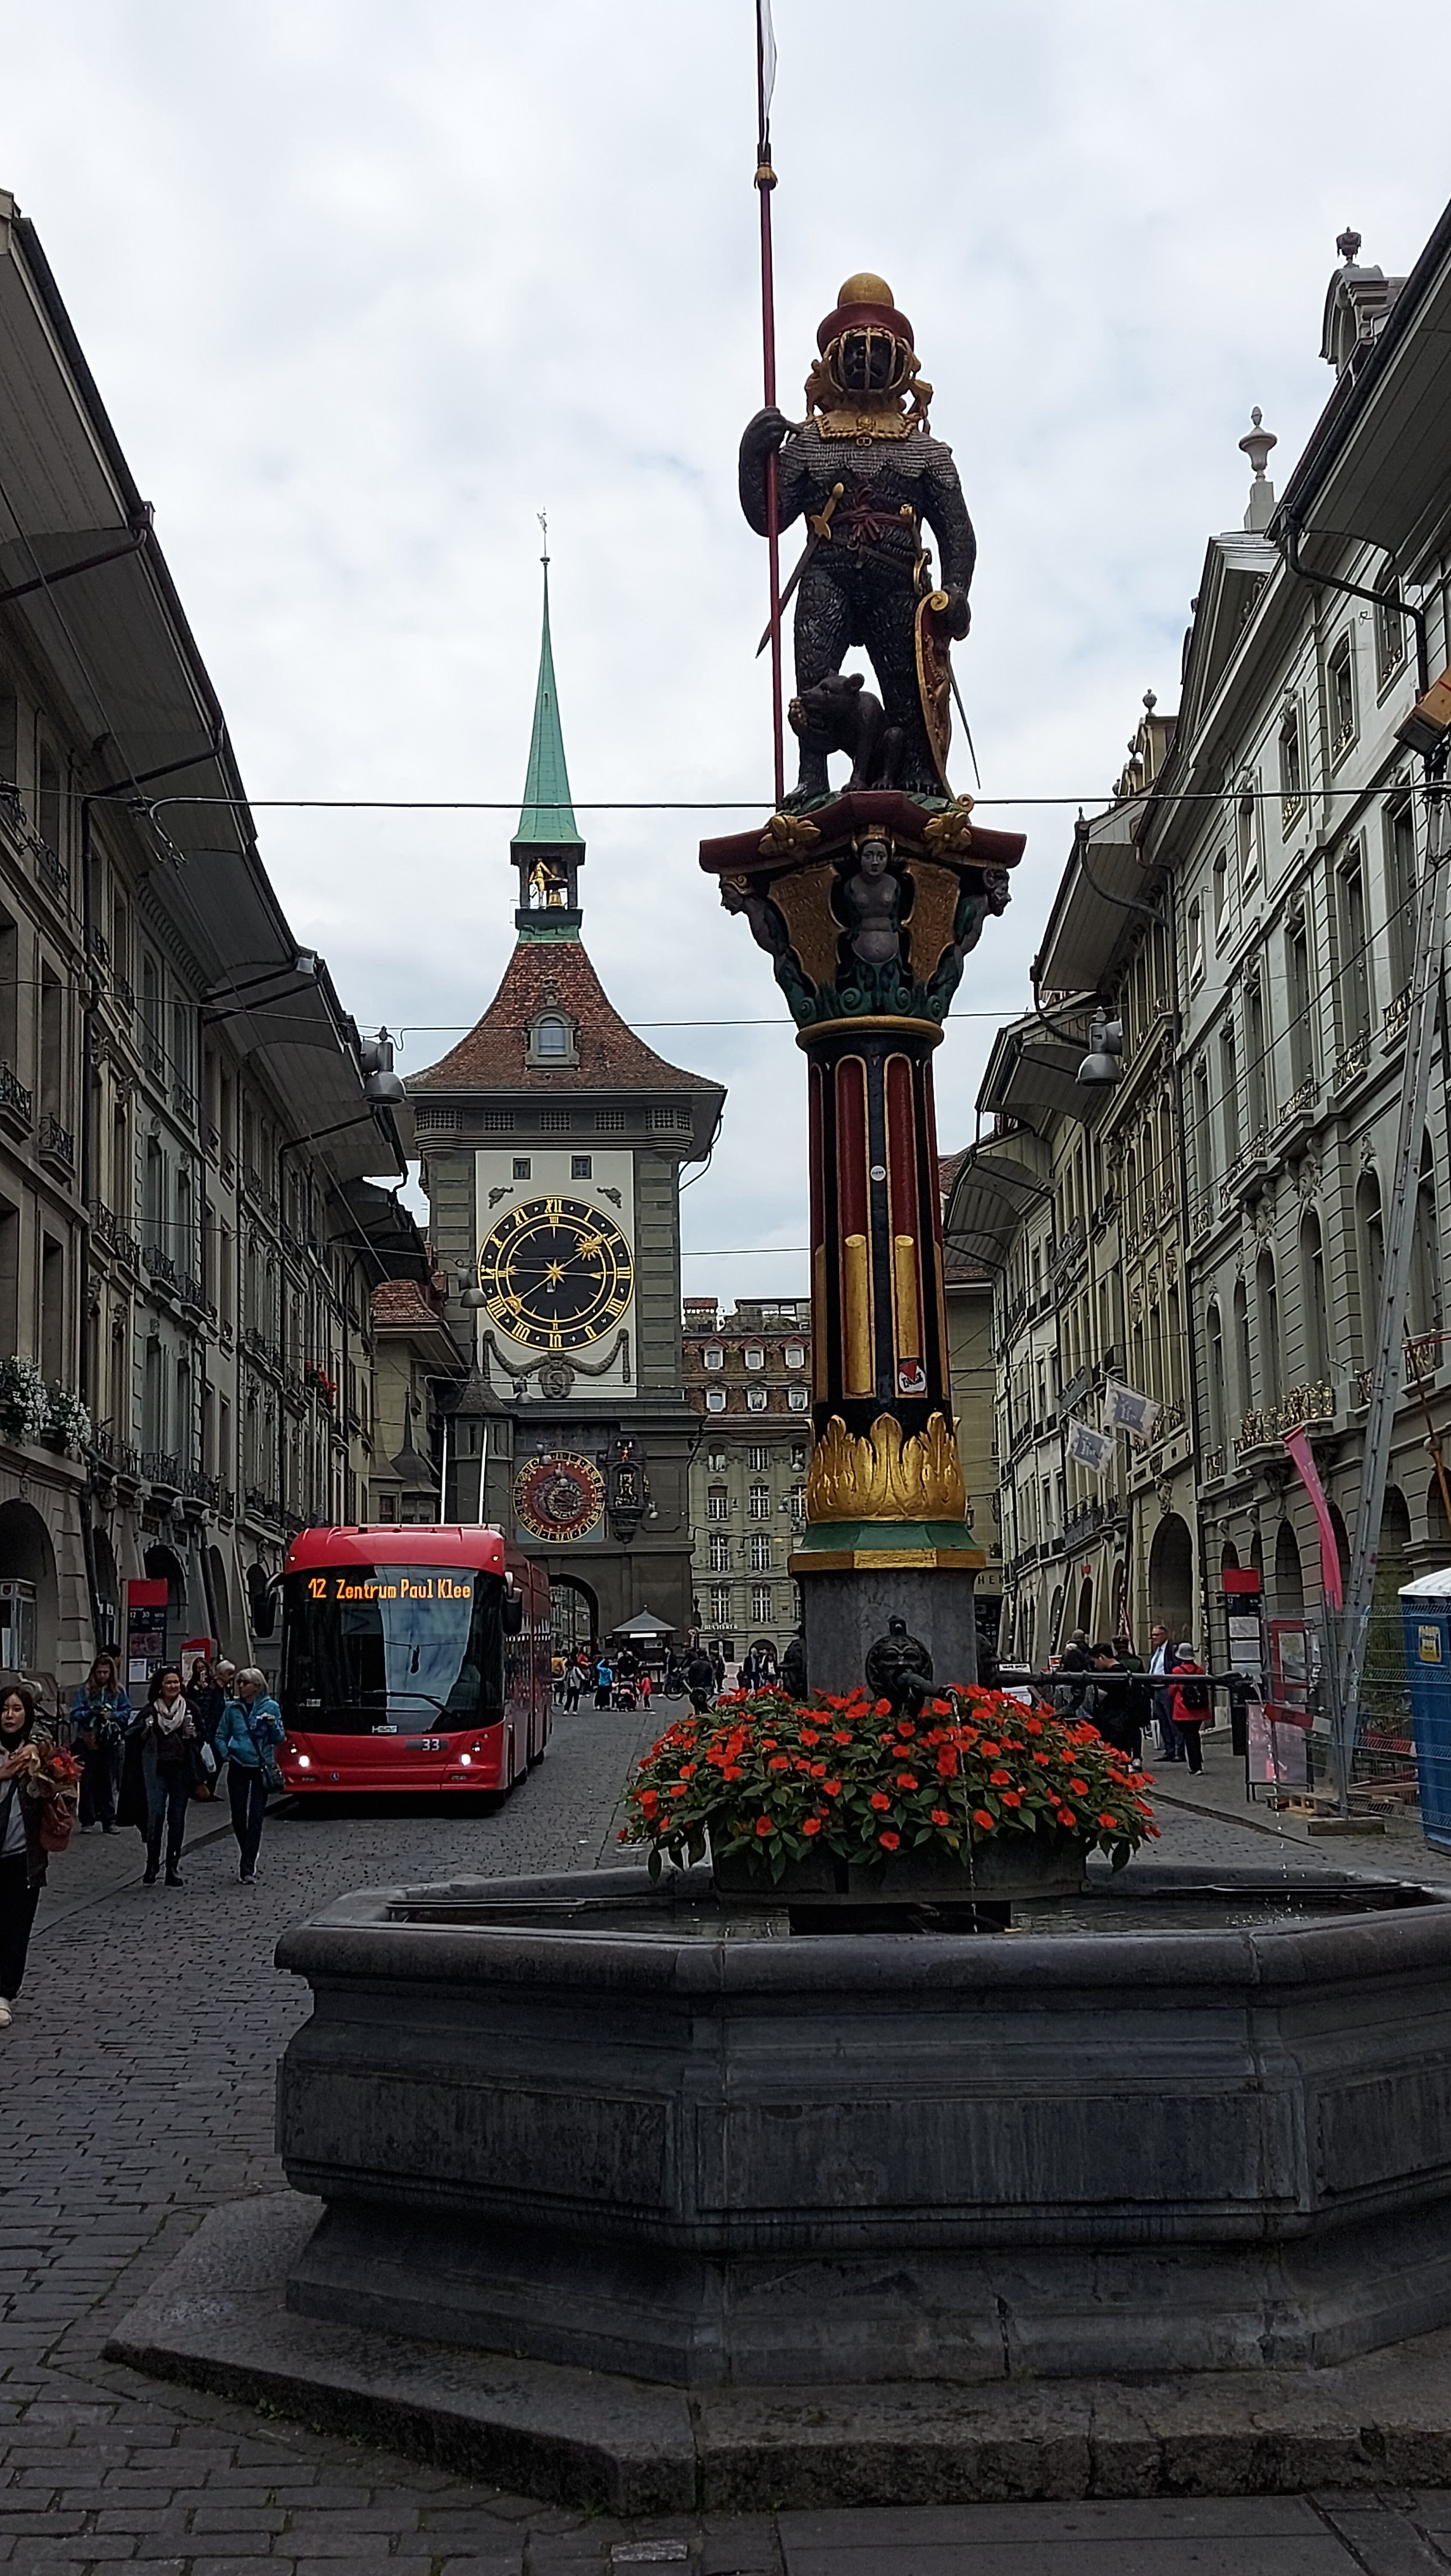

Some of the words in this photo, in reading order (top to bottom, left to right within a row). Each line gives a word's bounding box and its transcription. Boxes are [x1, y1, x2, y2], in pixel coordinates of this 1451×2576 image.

[544, 1199, 562, 1213] XII
[513, 1208, 529, 1226] XI
[583, 1208, 593, 1222] I
[490, 1233, 503, 1248] X
[607, 1232, 621, 1247] II
[616, 1266, 631, 1280] III
[308, 1578, 327, 1598] 12
[336, 1579, 397, 1599] Zentrum
[401, 1579, 434, 1598] Paul
[438, 1579, 471, 1599] Klee
[422, 1739, 440, 1751] 33
